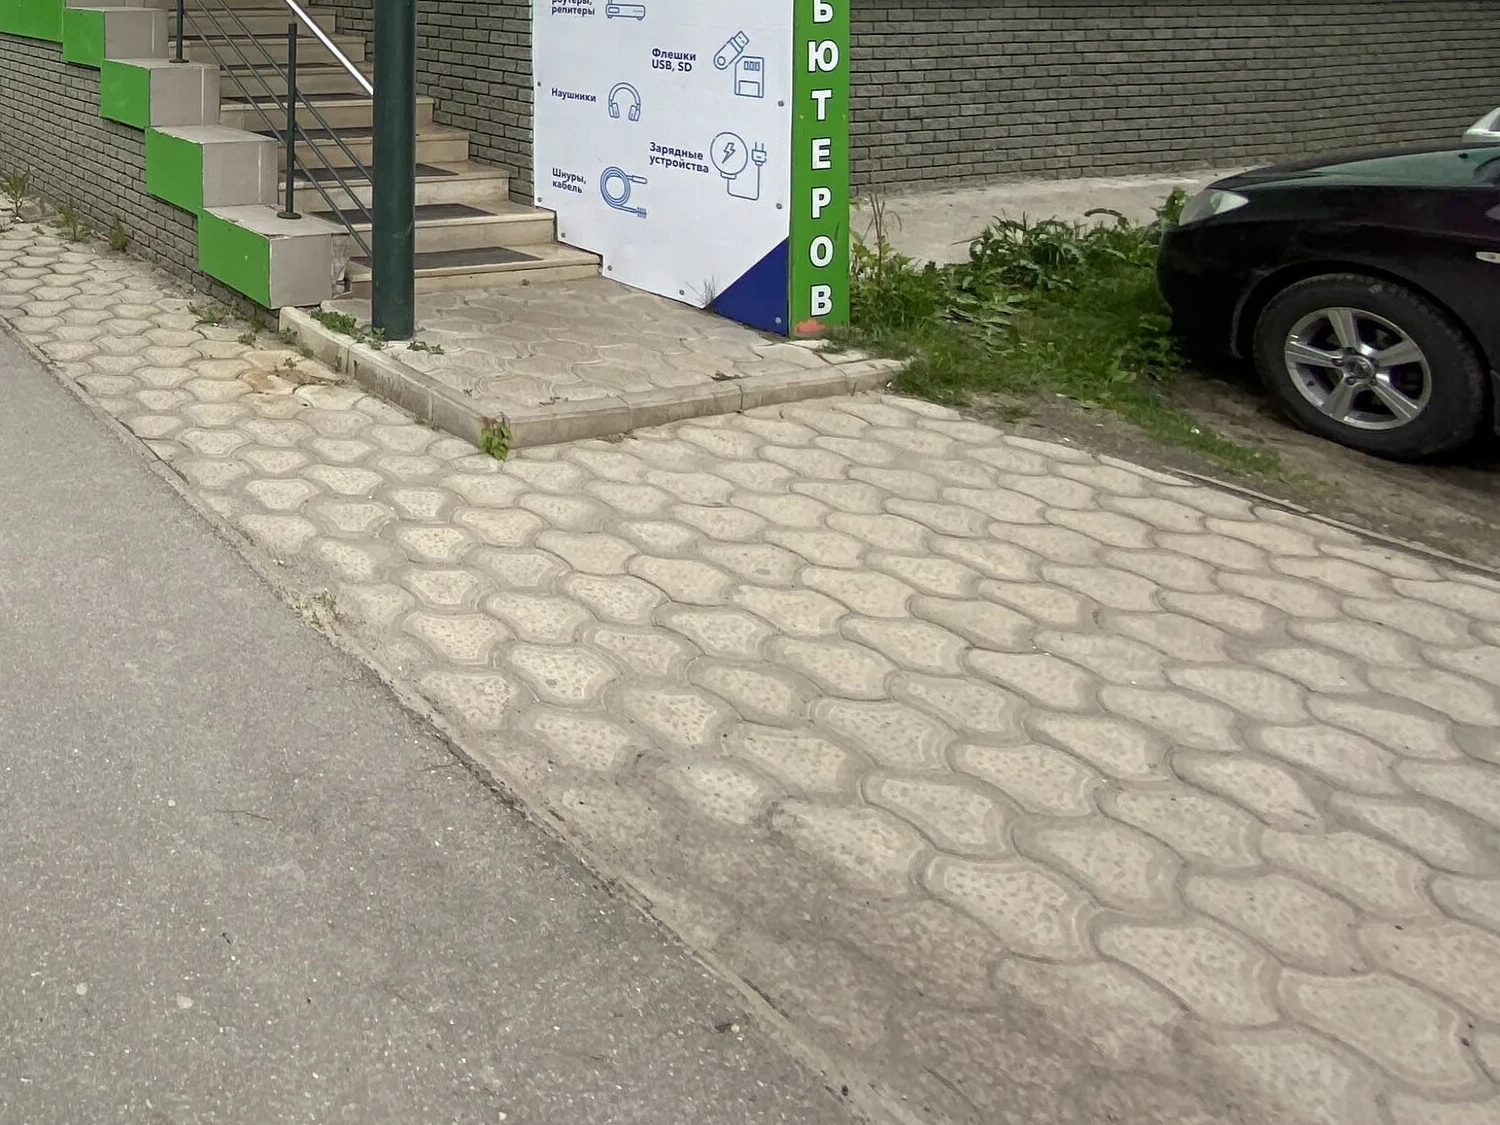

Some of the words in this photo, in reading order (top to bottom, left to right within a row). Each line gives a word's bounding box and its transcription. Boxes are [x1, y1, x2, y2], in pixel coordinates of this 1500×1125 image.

[551, 6, 596, 16] репитеры
[652, 48, 697, 61] Флешки
[652, 59, 675, 72] USB,
[678, 62, 693, 72] SD
[551, 88, 597, 102] Наушники
[650, 142, 704, 160] Зарядные
[649, 155, 709, 173] устройства
[552, 168, 587, 184] Шнуры,
[552, 180, 583, 193] кабель
